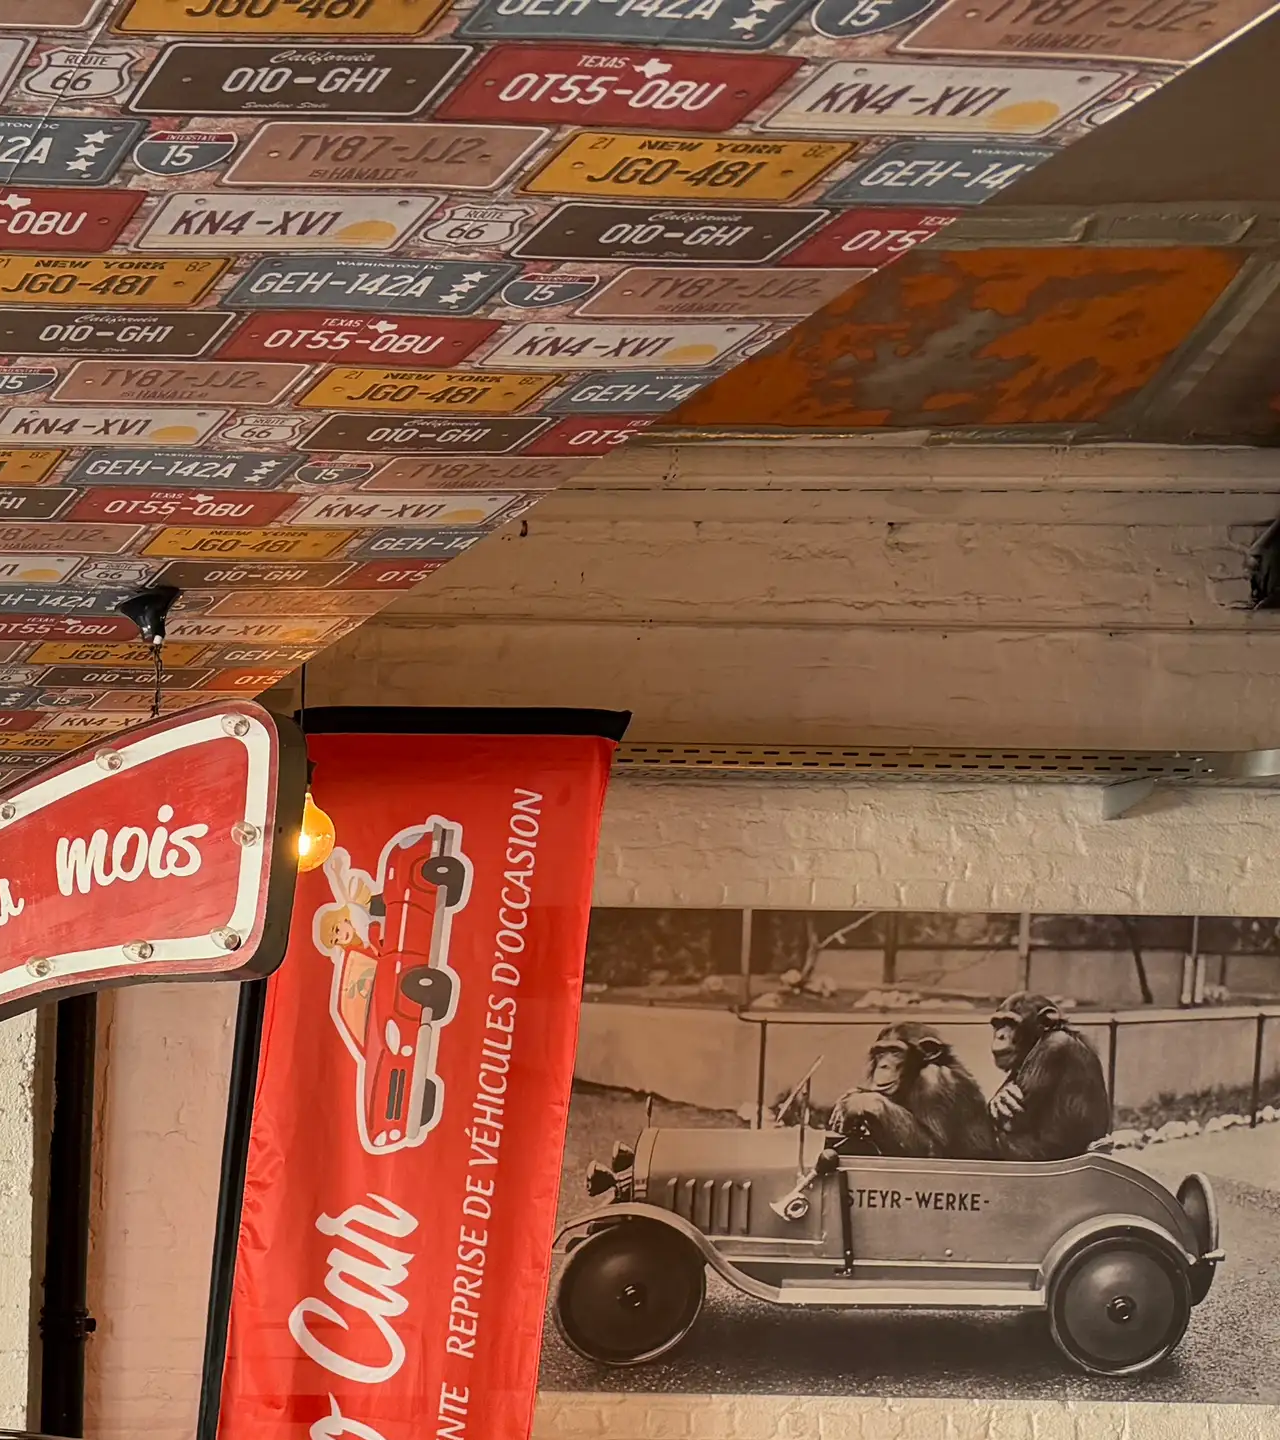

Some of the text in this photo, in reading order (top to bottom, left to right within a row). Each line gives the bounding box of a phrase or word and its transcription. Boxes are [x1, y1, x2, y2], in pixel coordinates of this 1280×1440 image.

[62, 54, 112, 66] ROUTE
[269, 49, 379, 66] California
[575, 58, 629, 70] TEXAS
[48, 70, 96, 92] 66
[158, 144, 199, 166] 15
[636, 140, 788, 155] NEW YORK
[249, 271, 437, 297] GEH-142A
[55, 804, 209, 897] mois
[492, 788, 543, 987] D'OCCASION
[464, 994, 517, 1166] VÉHICULES
[462, 1174, 494, 1222] DE
[288, 1193, 419, 1384] Car
[446, 1226, 488, 1360] REPRISE
